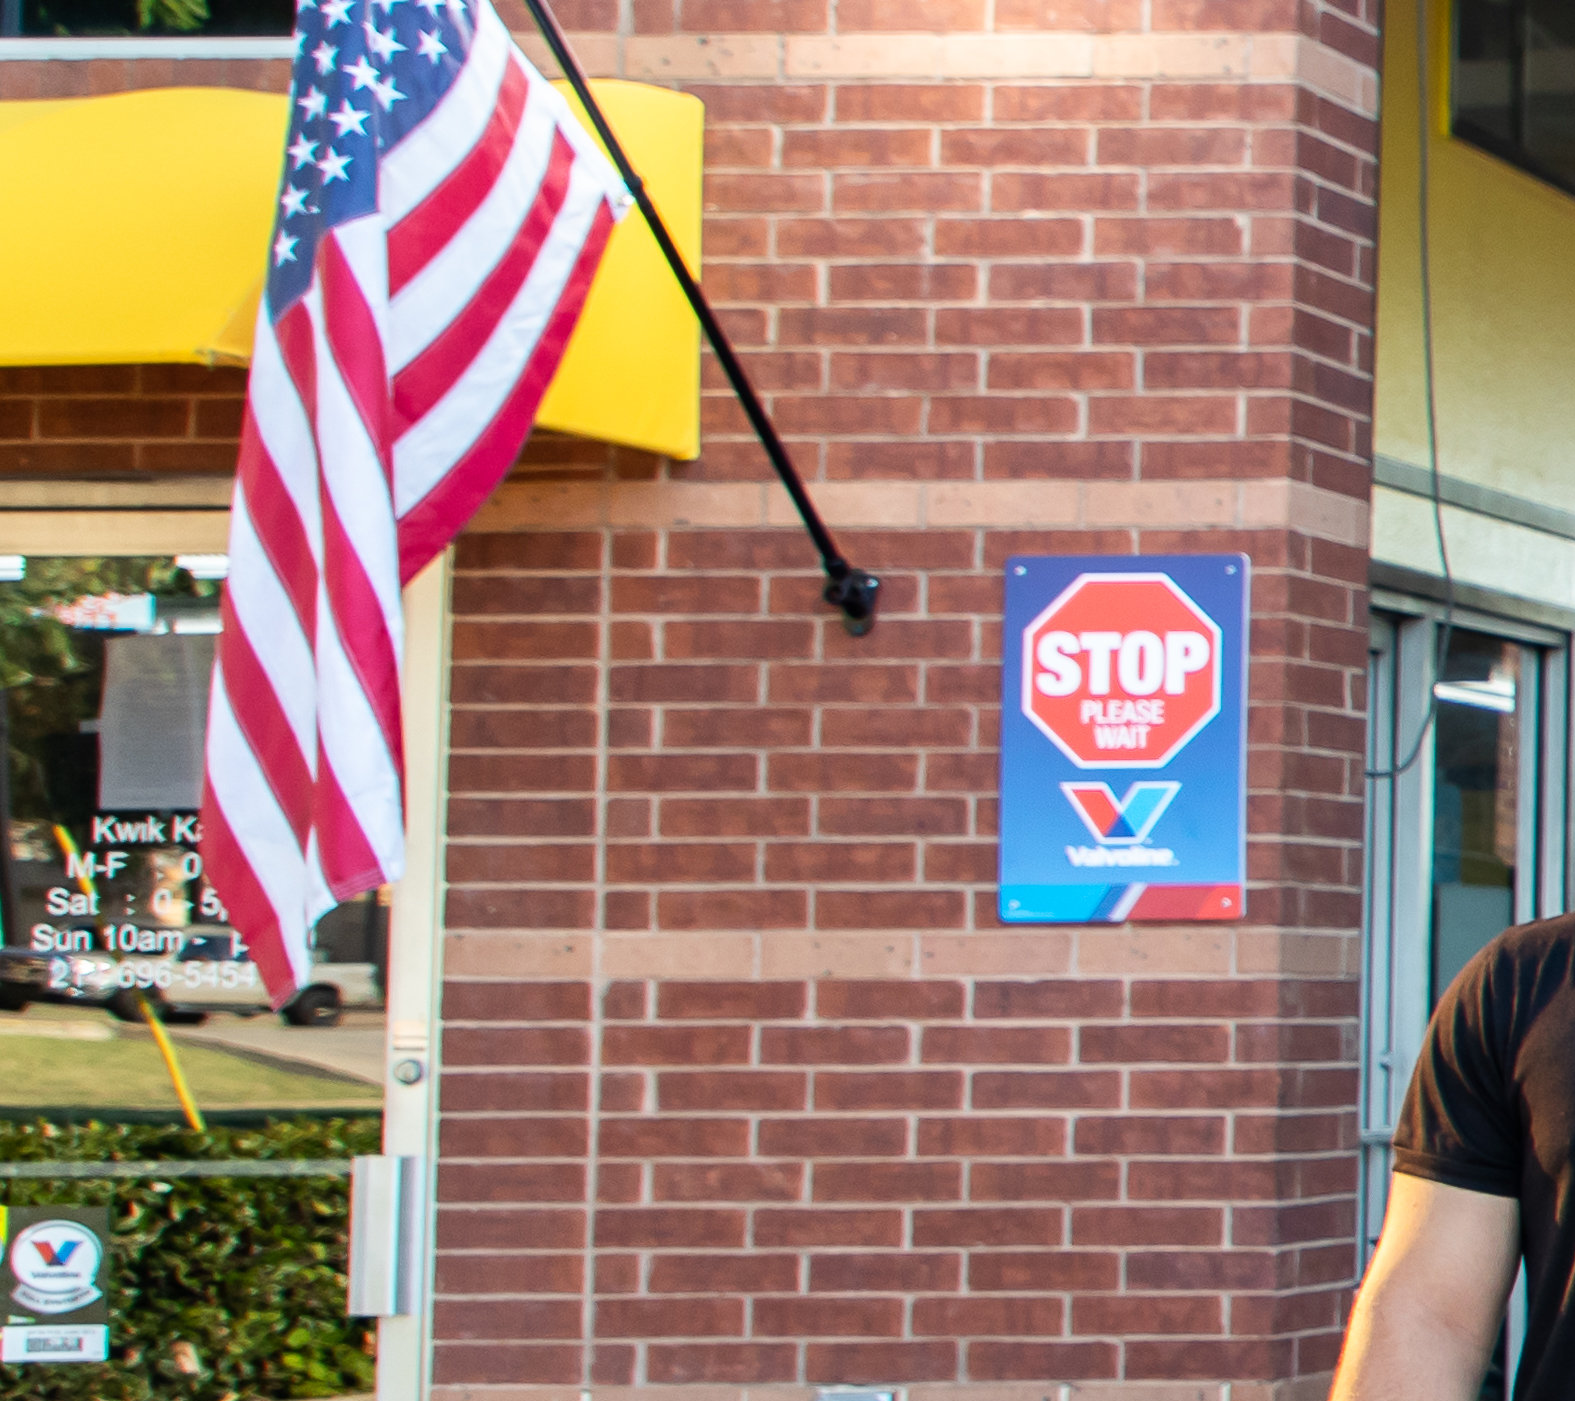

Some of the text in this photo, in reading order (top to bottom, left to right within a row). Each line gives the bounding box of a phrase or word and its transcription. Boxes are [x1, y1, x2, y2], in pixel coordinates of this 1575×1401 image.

[1035, 630, 1211, 697] STOP
[1080, 699, 1165, 725] PLEASE
[1093, 724, 1152, 750] WAIT
[91, 815, 167, 843] Kwik
[66, 851, 130, 879] M-F
[1065, 845, 1176, 867] Valvoline
[46, 886, 101, 916] Sat
[32, 923, 94, 952] Sun
[102, 924, 186, 952] 10am
